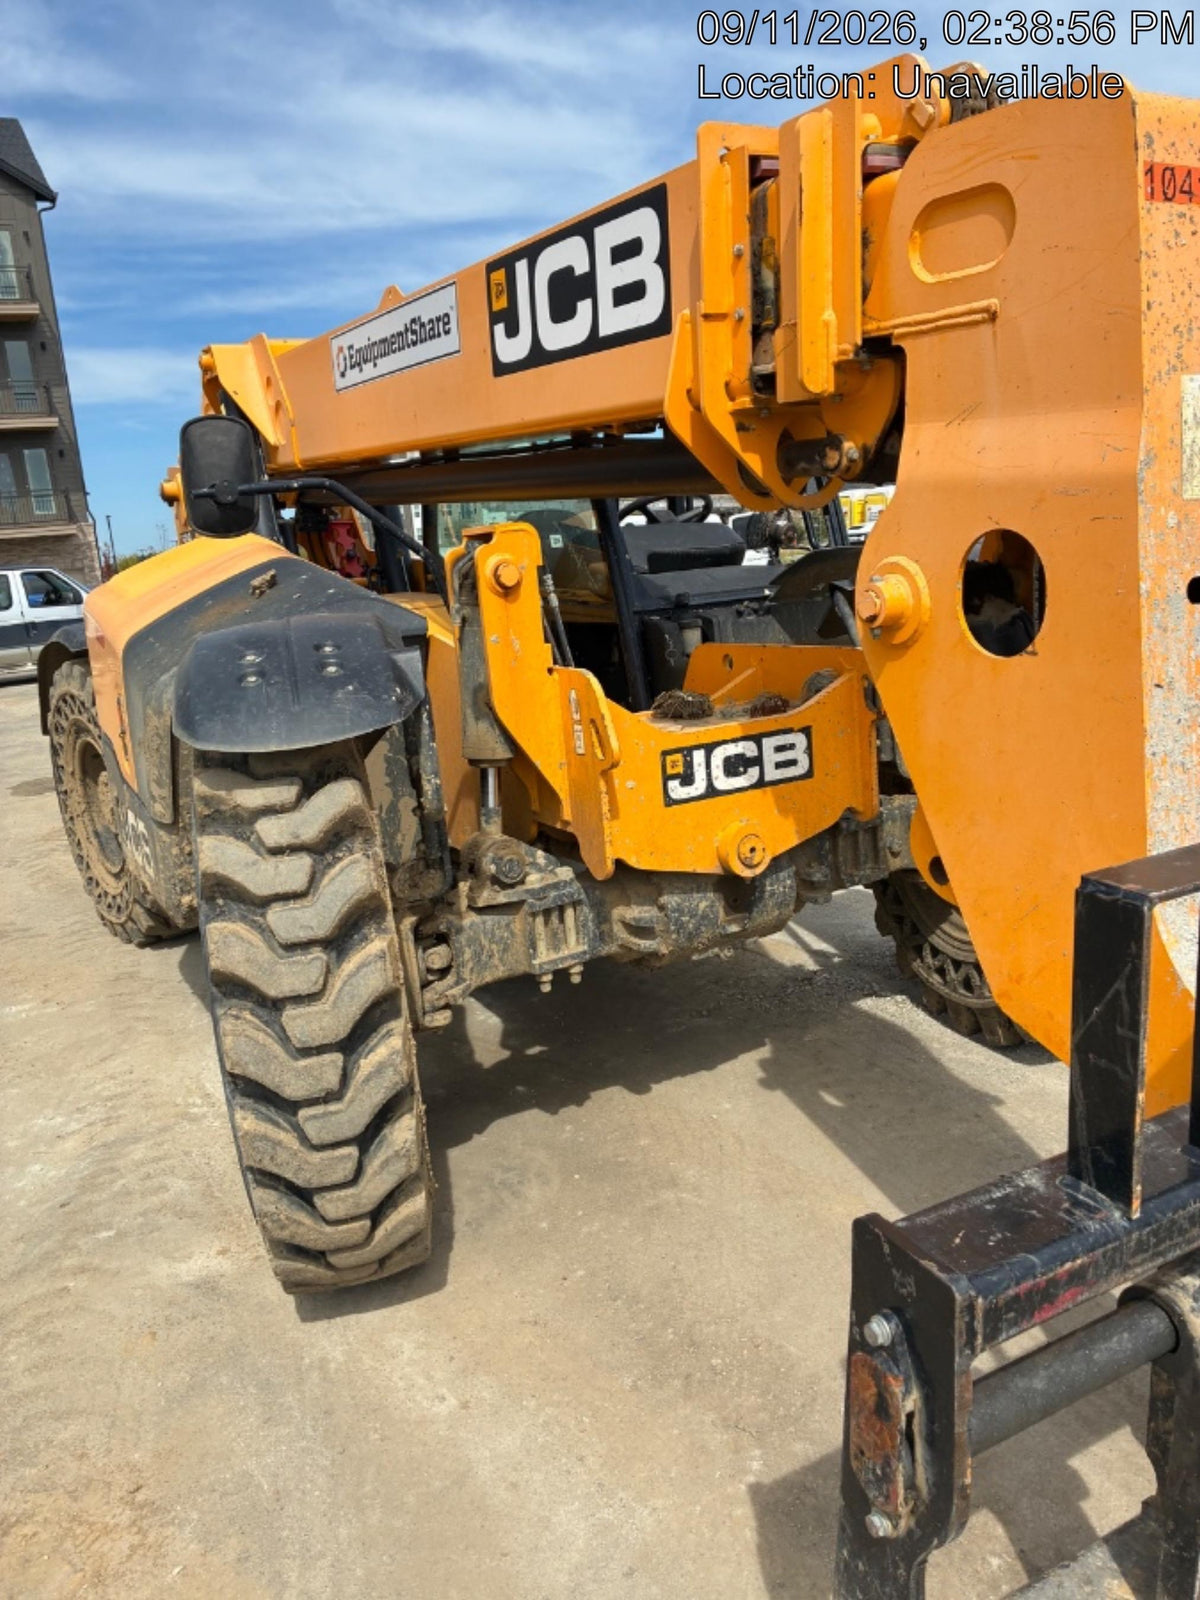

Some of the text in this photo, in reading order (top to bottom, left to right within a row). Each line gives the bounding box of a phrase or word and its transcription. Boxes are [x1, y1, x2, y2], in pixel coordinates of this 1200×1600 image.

[1144, 163, 1200, 203] 104
[494, 207, 665, 363] JCB
[347, 311, 452, 373] EquipmentShare
[667, 731, 809, 800] JCB
